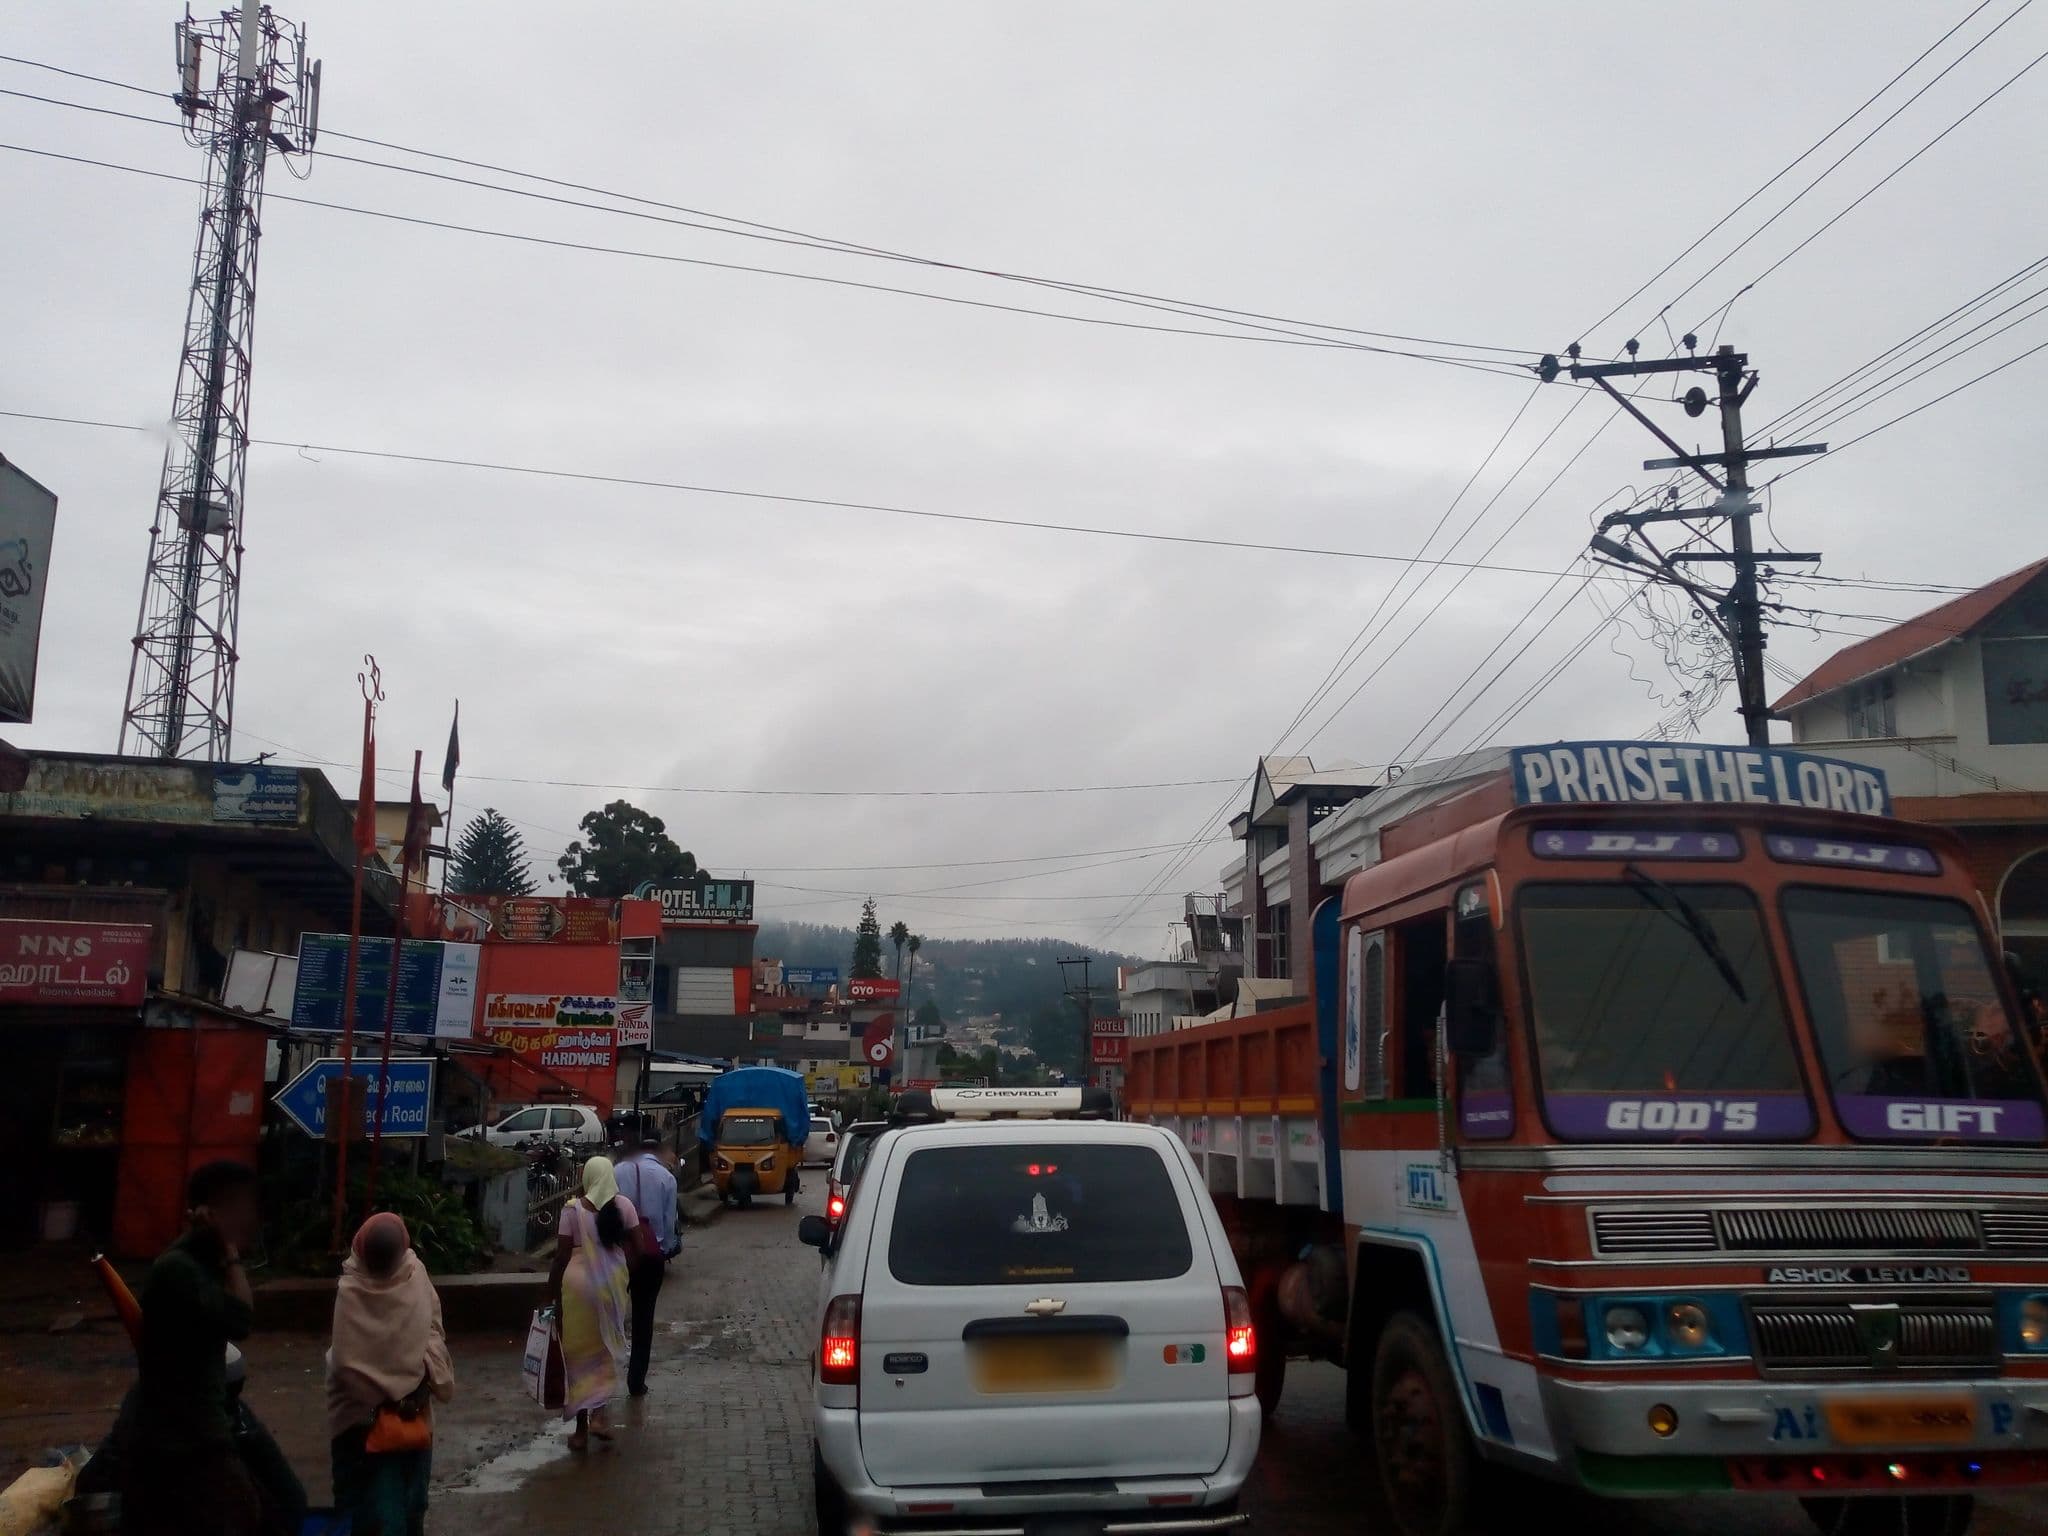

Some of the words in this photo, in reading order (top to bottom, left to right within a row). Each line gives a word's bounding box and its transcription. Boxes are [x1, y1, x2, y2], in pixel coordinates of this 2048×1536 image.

[1769, 755, 1885, 817] LORD
[1586, 836, 1680, 852] DJ
[1811, 843, 1882, 863] DJ
[650, 889, 700, 909] HOTEL
[662, 909, 690, 917] OOMS
[692, 910, 743, 918] AVAILABLE
[852, 985, 874, 996] OYO
[617, 1020, 649, 1030] HONDA
[1094, 1020, 1123, 1032] HOTEL
[541, 1052, 611, 1067] HARDWARE
[985, 1090, 1058, 1098] CHEVROLET
[391, 1105, 424, 1123] Road
[1605, 1100, 1758, 1131] GOD'S
[1886, 1103, 2003, 1134] GIFT
[1768, 1267, 1856, 1284] ASHOK
[1864, 1266, 1971, 1283] LEYLAND
